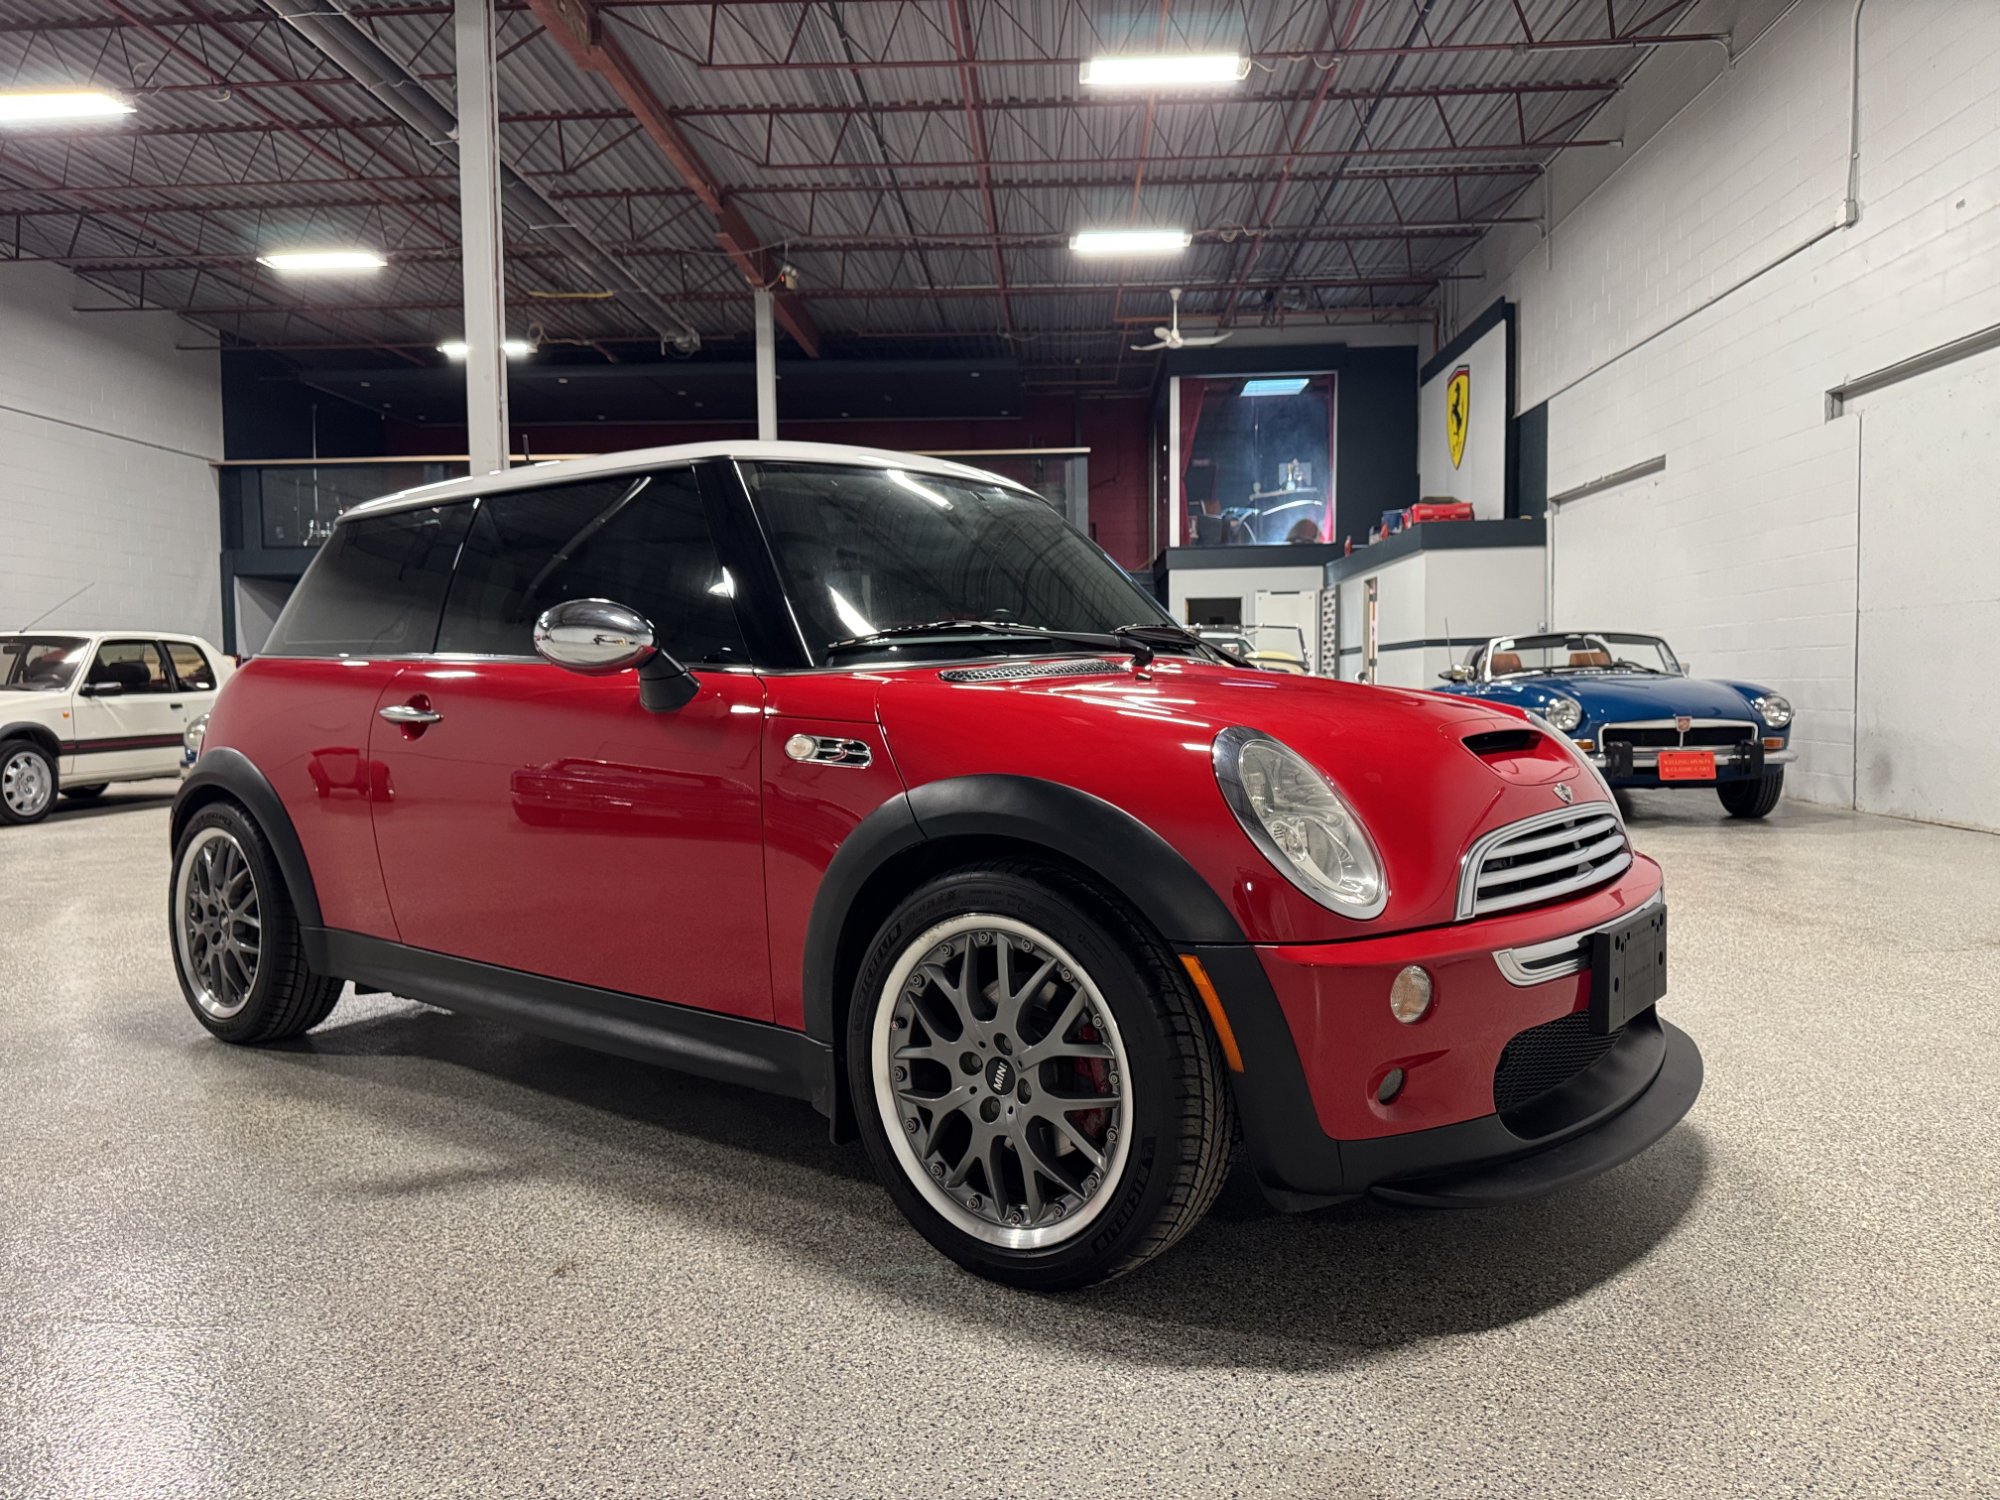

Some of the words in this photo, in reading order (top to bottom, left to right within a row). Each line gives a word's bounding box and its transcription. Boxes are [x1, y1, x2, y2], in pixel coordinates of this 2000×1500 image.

[859, 923, 899, 1007] MICHELIN
[993, 1062, 1008, 1091] MINI
[1095, 1165, 1149, 1250] MICHELIN
